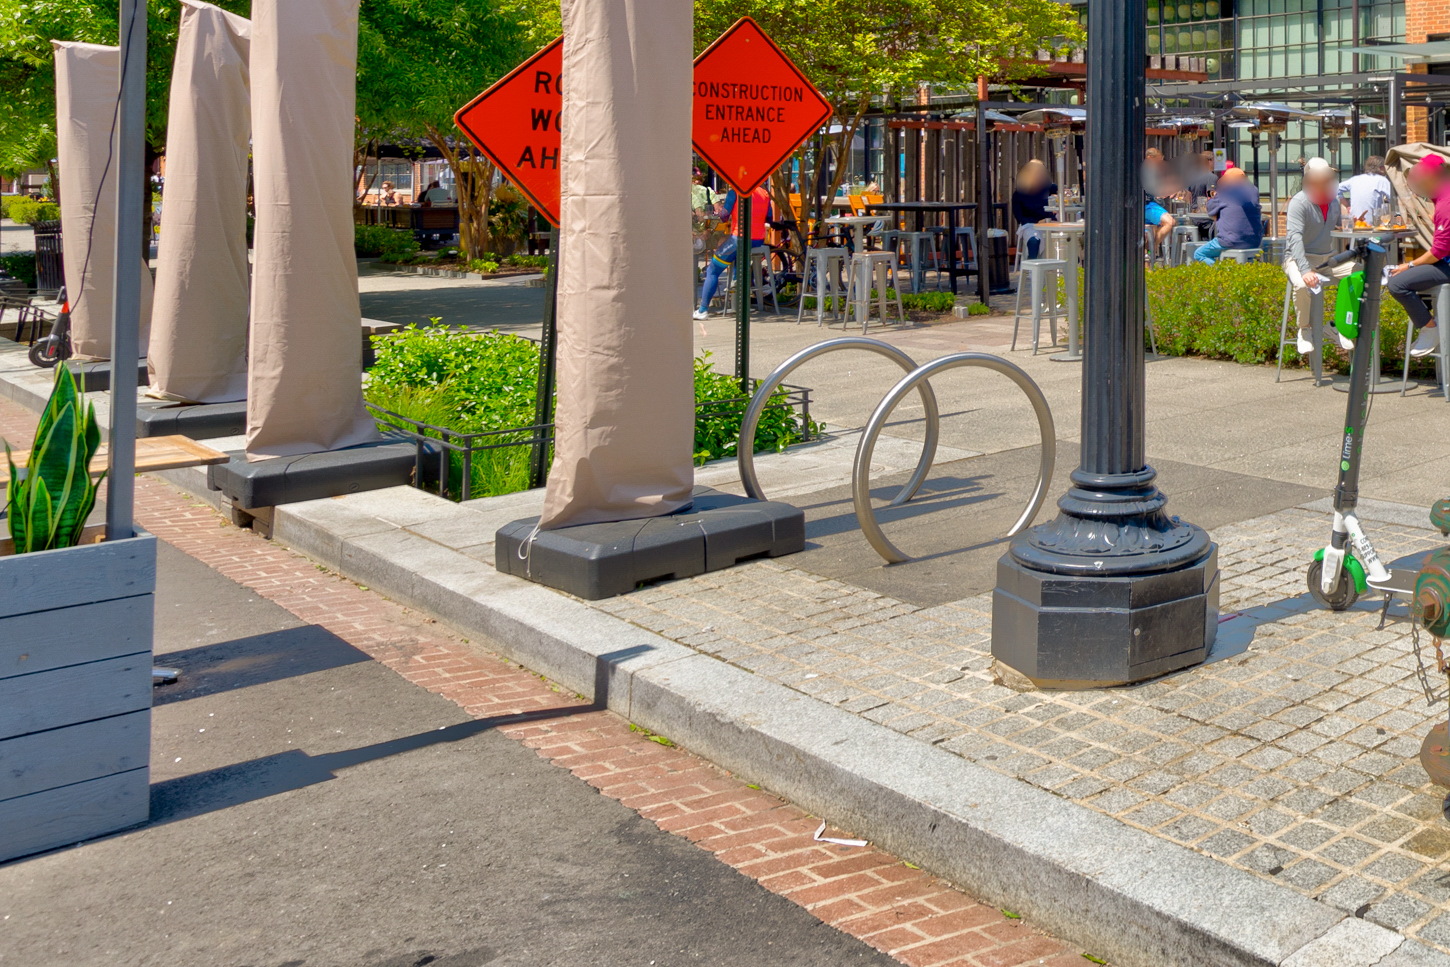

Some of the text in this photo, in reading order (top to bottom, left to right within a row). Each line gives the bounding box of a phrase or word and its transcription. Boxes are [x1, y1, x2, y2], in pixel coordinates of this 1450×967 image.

[692, 81, 803, 103] ONSTRUCTION
[705, 103, 786, 123] ENTRANCE
[720, 127, 772, 144] AHEAD
